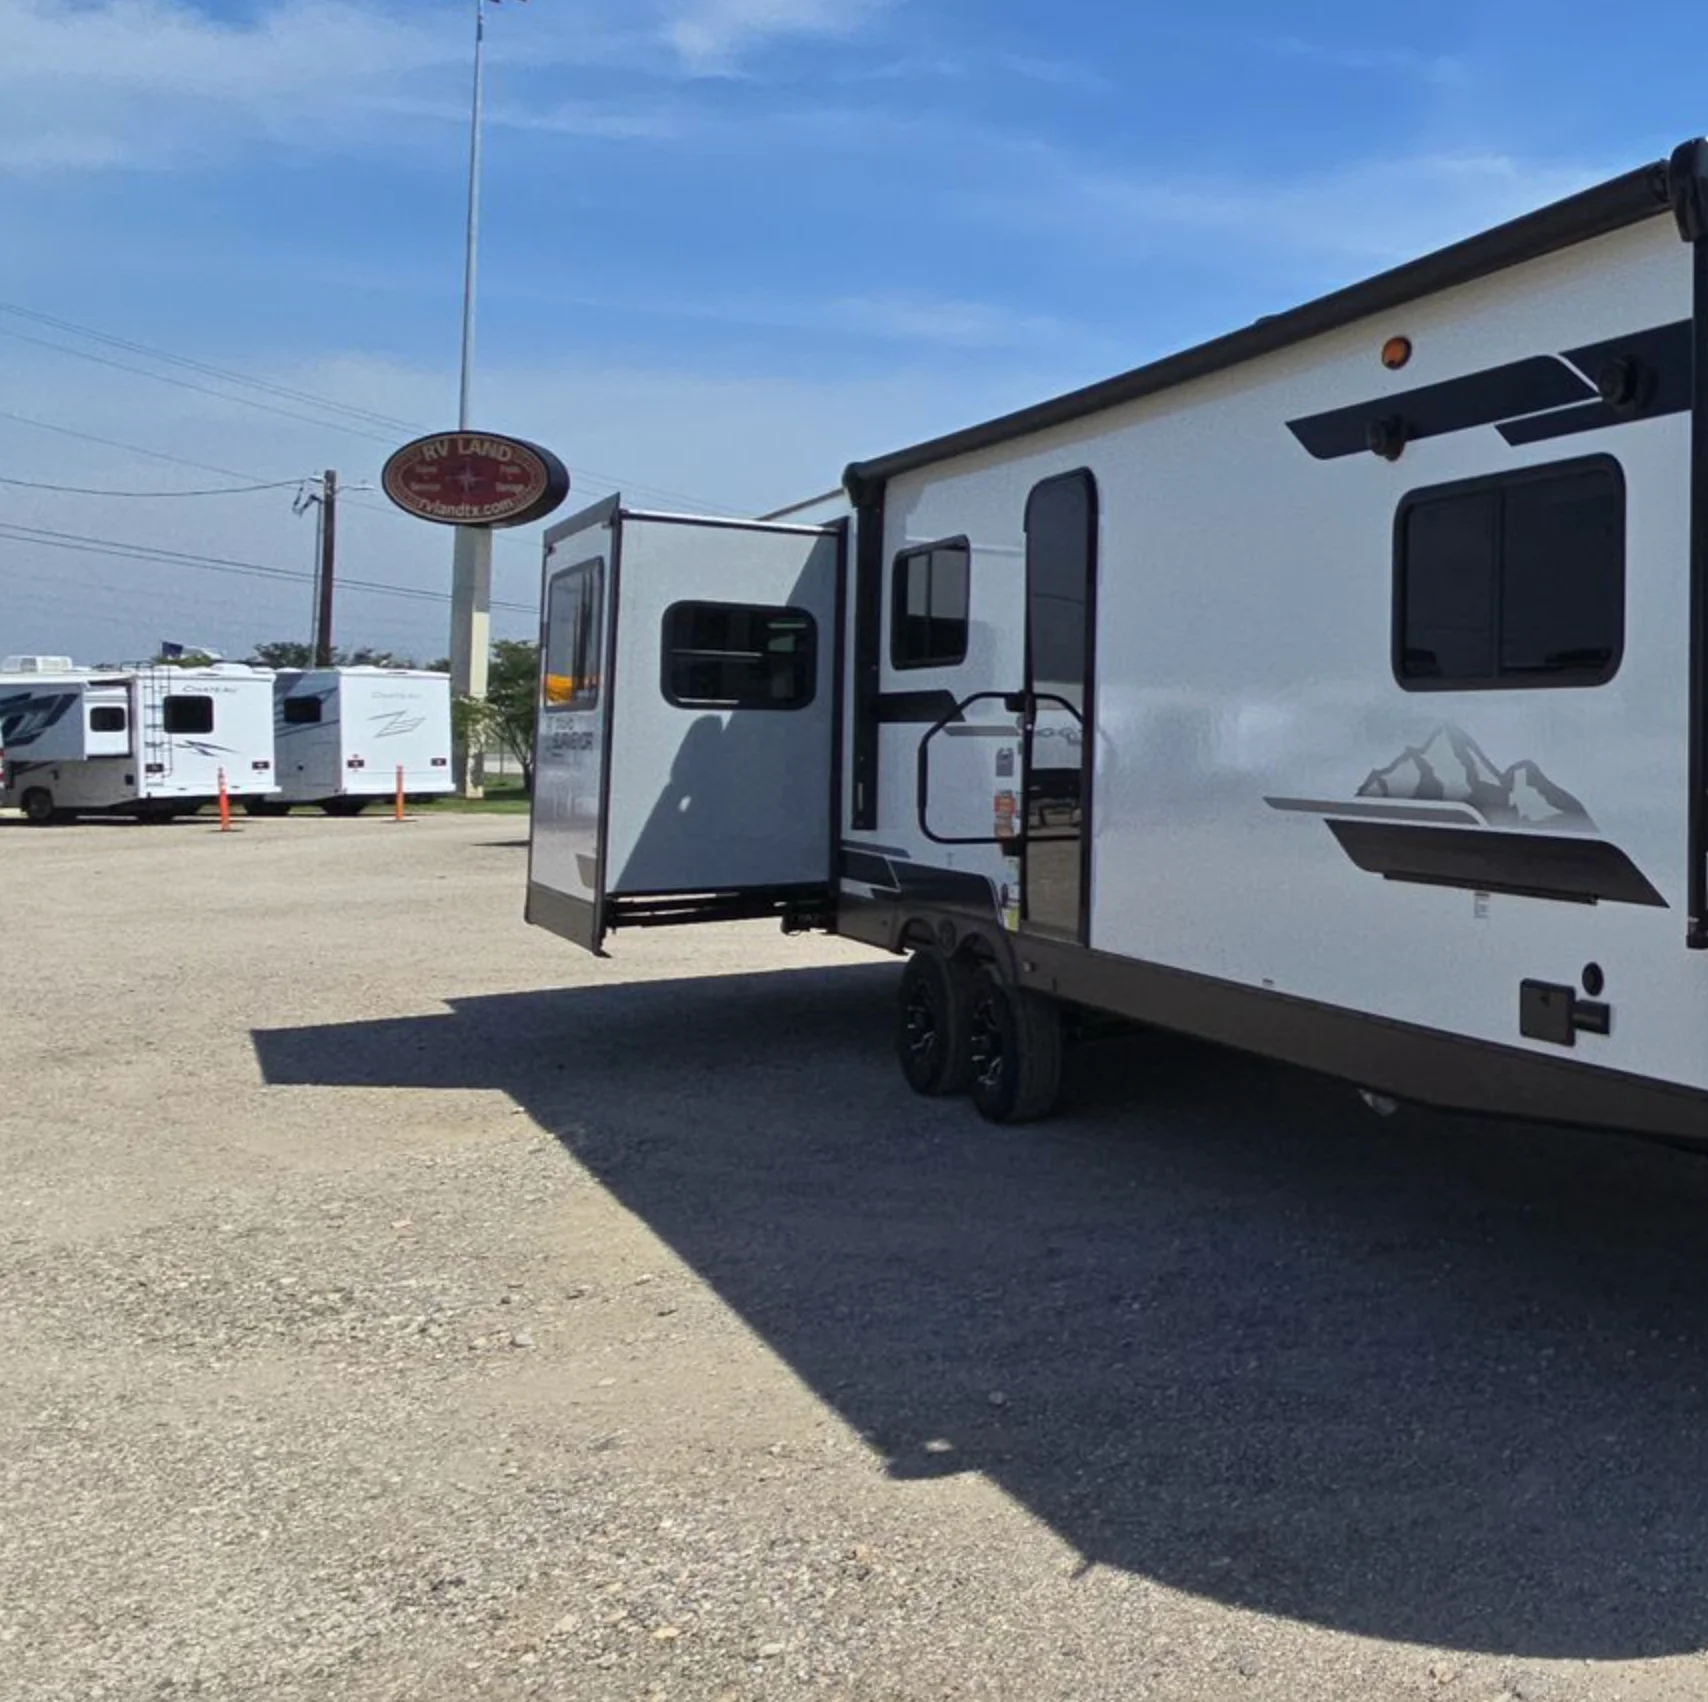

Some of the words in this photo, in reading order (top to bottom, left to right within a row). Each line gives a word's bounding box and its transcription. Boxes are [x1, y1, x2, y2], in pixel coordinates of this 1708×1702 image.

[422, 440, 449, 461] RV
[457, 439, 512, 461] LAND
[417, 498, 514, 517] rvlandtx.com
